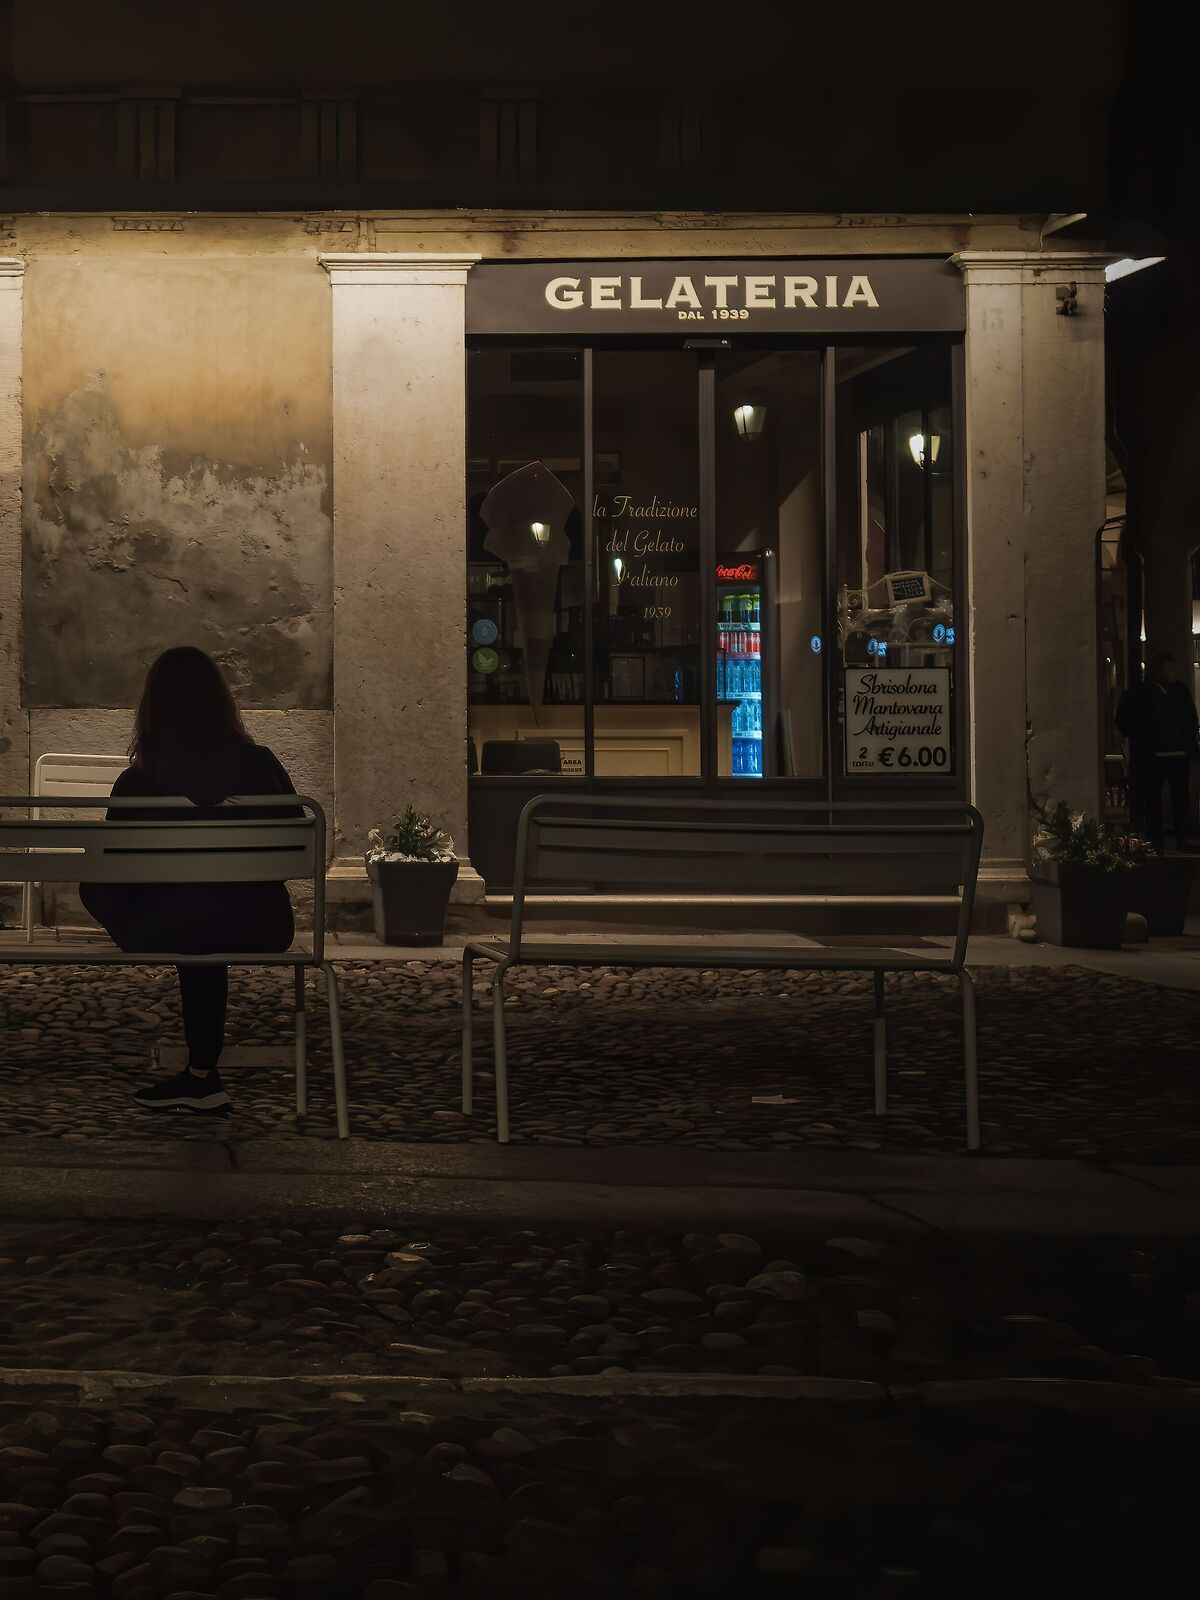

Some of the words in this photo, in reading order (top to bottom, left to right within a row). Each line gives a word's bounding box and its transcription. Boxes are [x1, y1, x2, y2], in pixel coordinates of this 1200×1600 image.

[545, 275, 880, 309] GELATERIA
[678, 311, 705, 320] DAL
[711, 309, 750, 320] 1939
[592, 494, 606, 517] la
[611, 495, 698, 518] Tradizione
[605, 529, 630, 552] del
[634, 529, 684, 558] Gelato
[611, 561, 679, 587] Ialiano
[644, 606, 672, 619] 1939
[857, 673, 937, 694] Sbrisolona
[853, 694, 943, 715] Mantovana
[853, 714, 942, 741] Artigianale
[859, 746, 868, 759] 2
